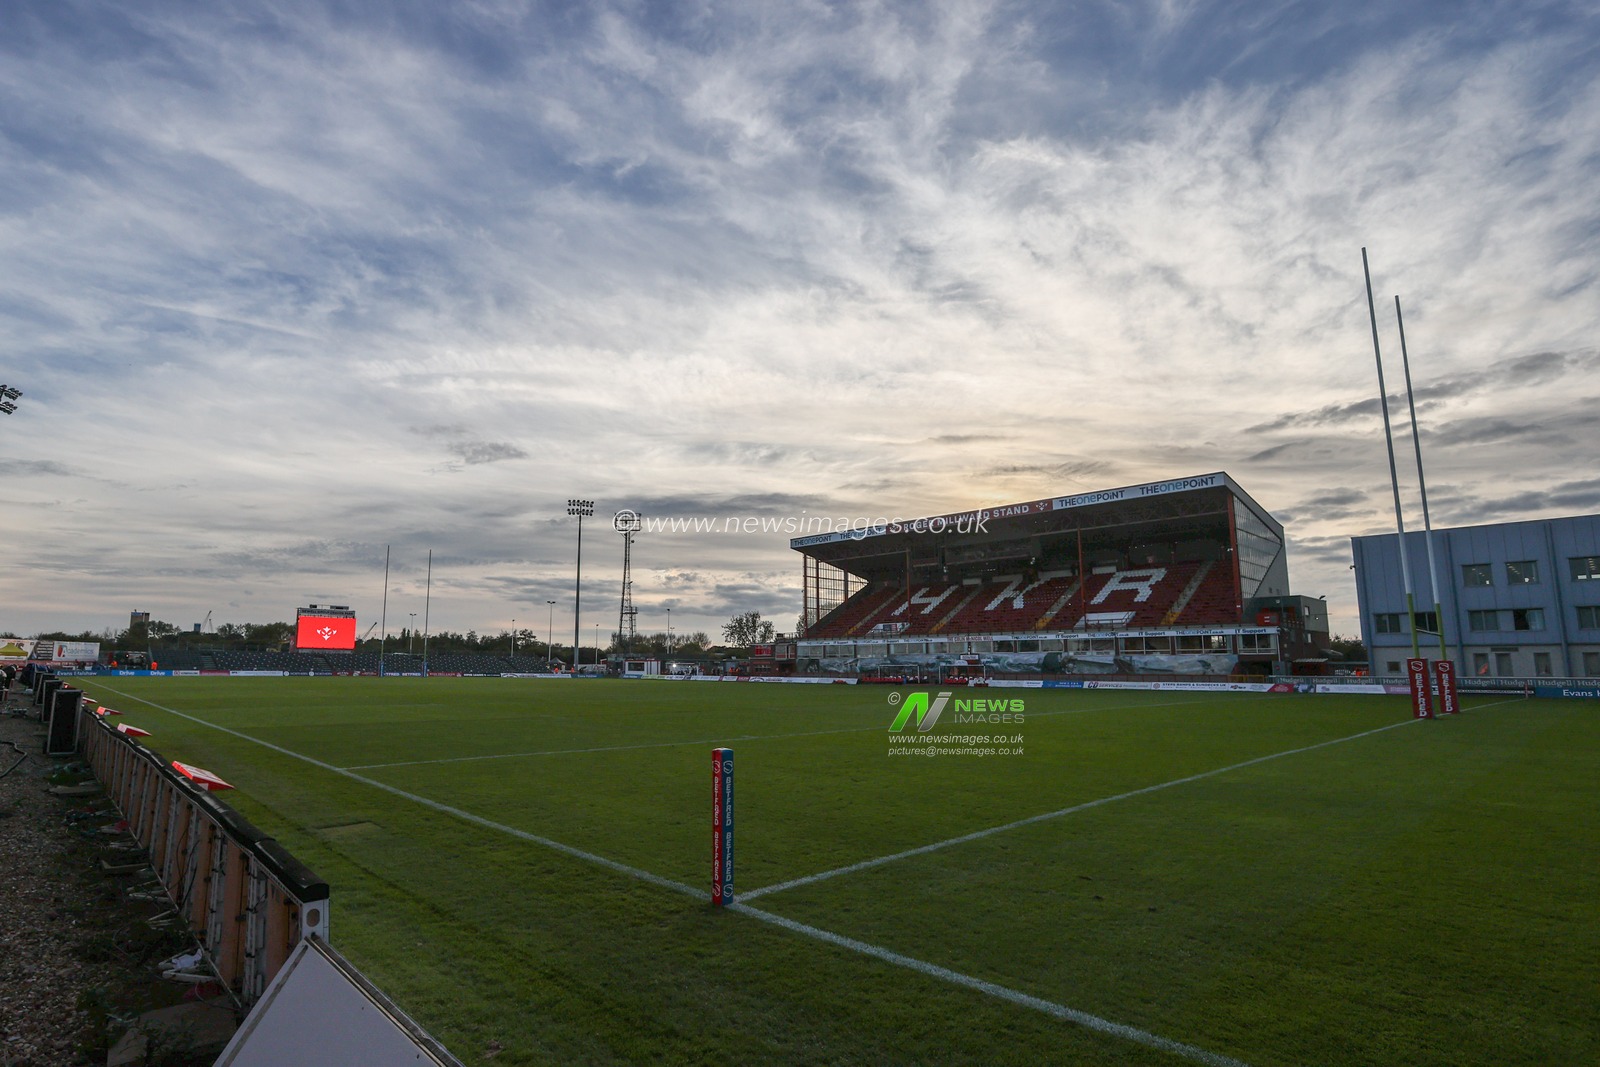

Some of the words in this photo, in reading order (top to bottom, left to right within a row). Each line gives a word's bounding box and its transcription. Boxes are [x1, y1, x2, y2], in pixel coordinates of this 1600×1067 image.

[904, 520, 934, 531] ROGER
[938, 511, 990, 526] MILLWARD
[993, 505, 1029, 518] STAND
[1415, 673, 1427, 716] BETFRED
[1442, 673, 1453, 711] BETFRED
[1464, 679, 1496, 688] Hudgell
[1538, 680, 1572, 688] Hudgell
